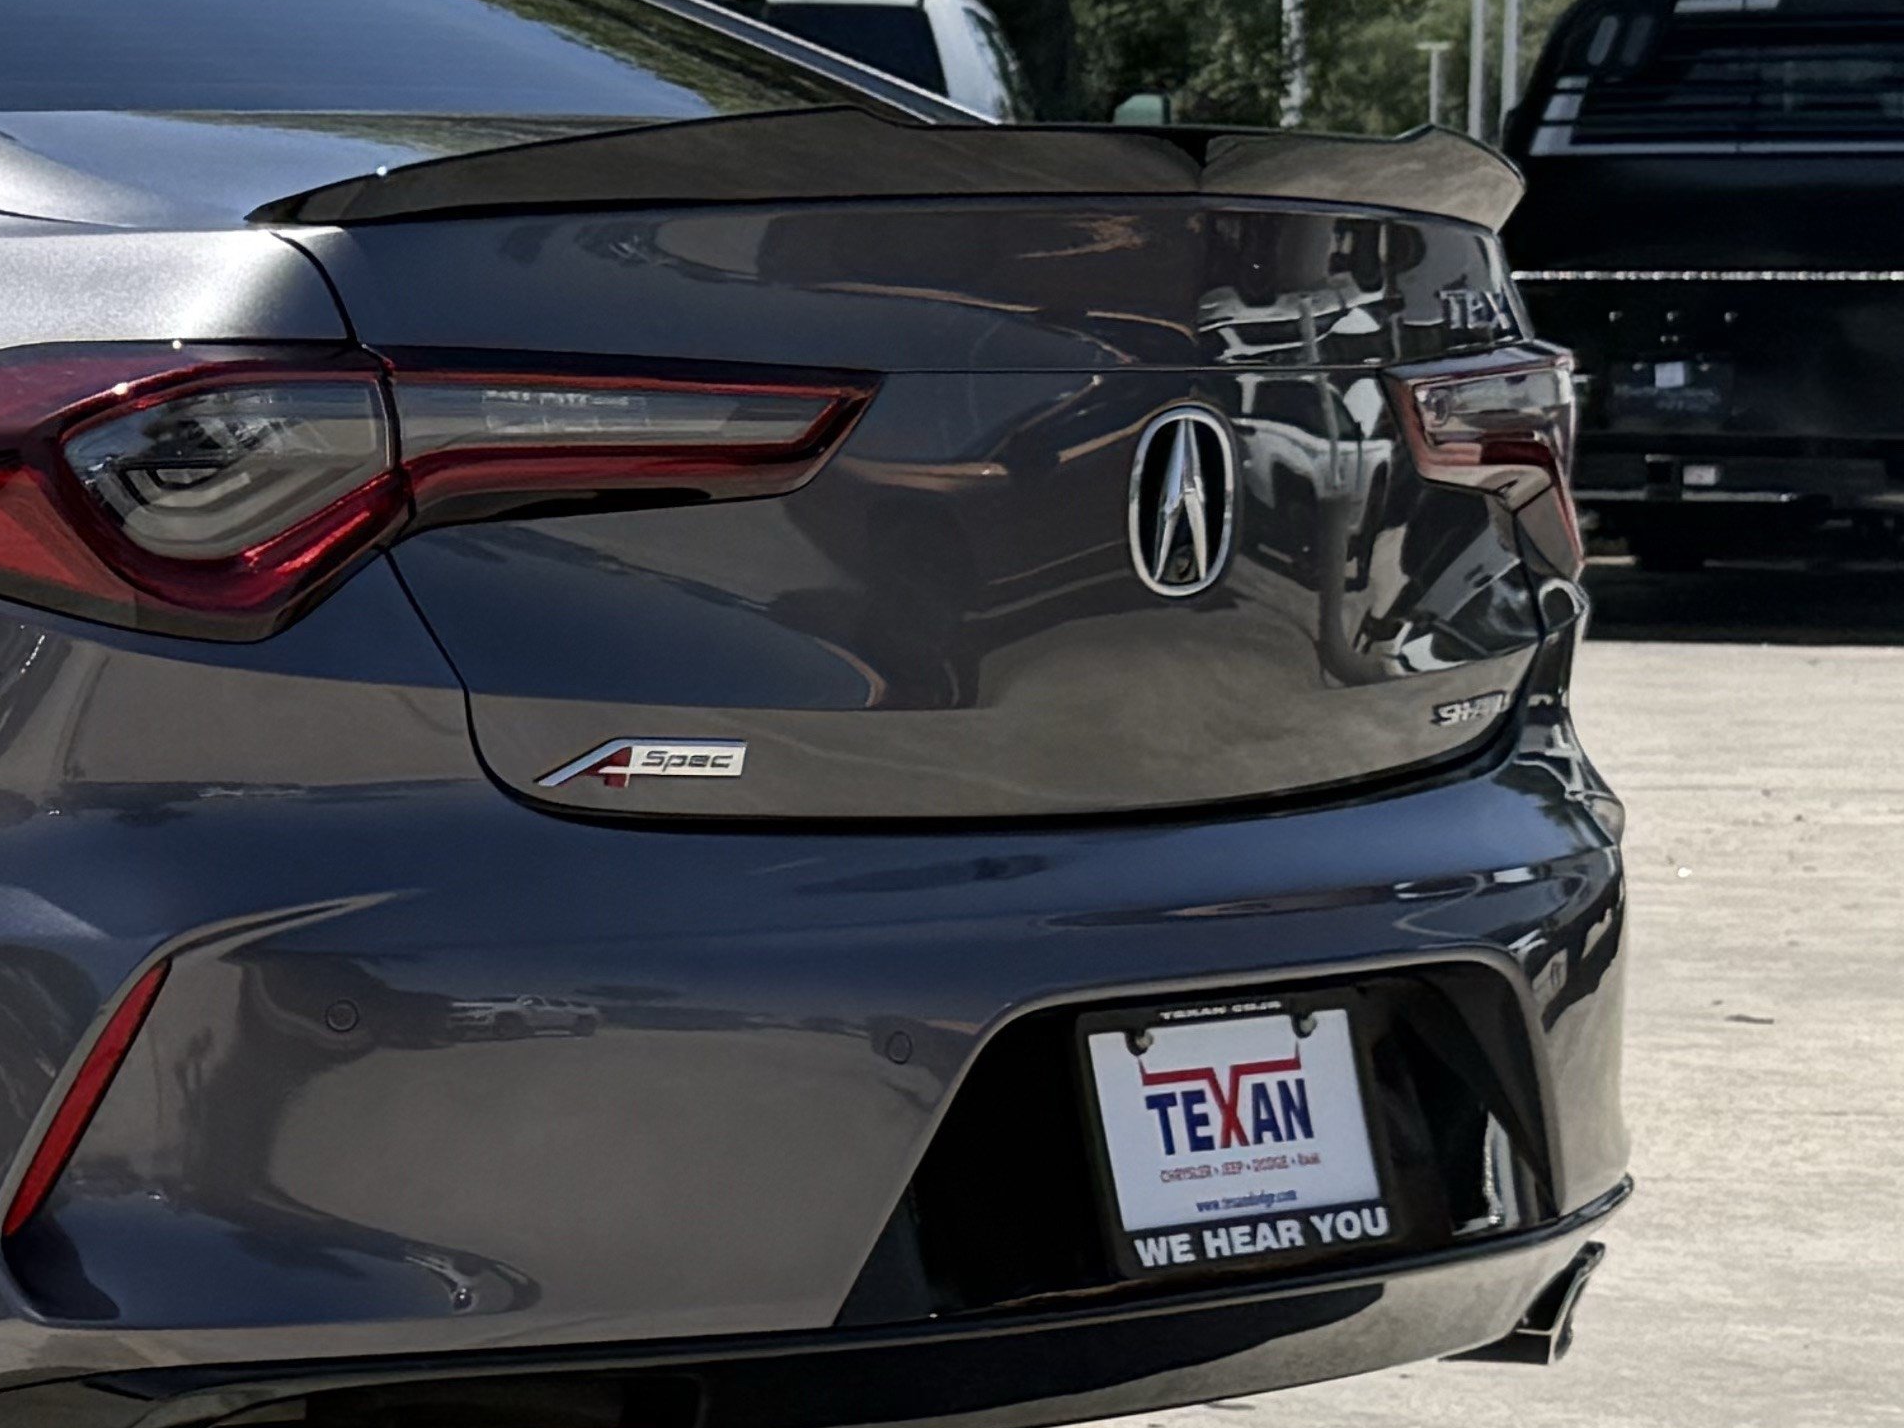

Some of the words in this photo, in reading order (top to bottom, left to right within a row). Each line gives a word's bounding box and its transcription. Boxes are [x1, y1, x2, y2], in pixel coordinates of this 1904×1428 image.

[1143, 1062, 1315, 1156] TEXAN
[1133, 1232, 1196, 1268] WE
[1202, 1219, 1305, 1261] HEAR
[1309, 1206, 1390, 1244] YOU
